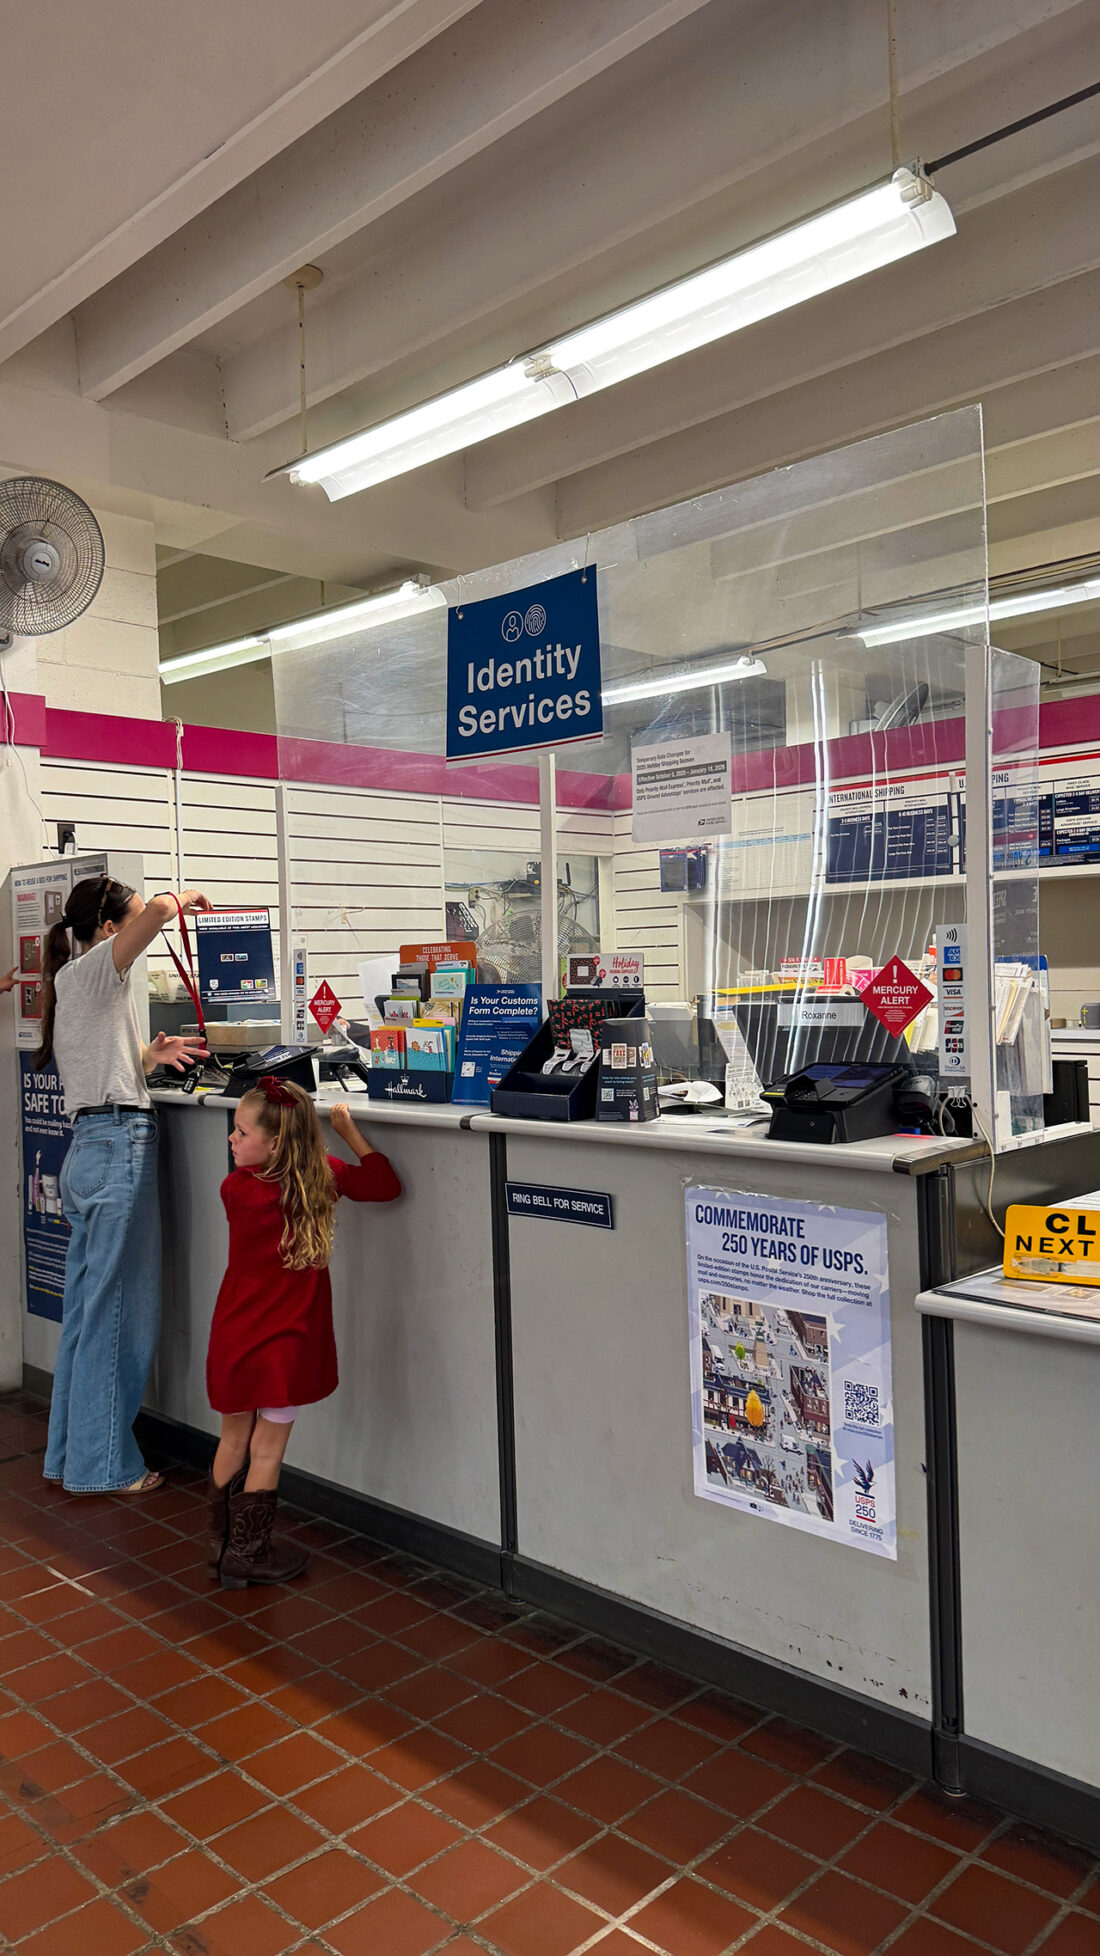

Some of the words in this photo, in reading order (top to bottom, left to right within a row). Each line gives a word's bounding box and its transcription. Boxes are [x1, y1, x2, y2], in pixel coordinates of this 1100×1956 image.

[467, 643, 582, 694] Identity
[457, 690, 591, 737] Services
[666, 751, 684, 759] Changes
[661, 759, 678, 768] Shipping
[686, 780, 700, 788] Priority
[828, 790, 873, 804] NTERNATIONAL
[198, 916, 221, 924] LIMITED
[422, 945, 451, 954] CELEBRATING
[612, 956, 640, 973] Holiday
[873, 985, 918, 995] MERCURY
[470, 996, 478, 1004] Is
[481, 996, 499, 1004] Your
[501, 996, 538, 1004] Customs
[880, 996, 910, 1005] ALERT
[469, 1007, 490, 1015] Form
[492, 1006, 538, 1016] Complete?
[802, 1010, 836, 1020] Roxanne
[23, 1073, 32, 1088] IS
[33, 1073, 57, 1090] YOUR
[385, 1080, 427, 1099] Hallmark
[25, 1092, 49, 1114] SAFE
[51, 1095, 66, 1115] TO
[32, 1117, 42, 1125] could
[42, 1118, 47, 1126] be
[48, 1120, 62, 1130] mailing
[512, 1193, 531, 1204] RING
[533, 1195, 552, 1207] BELL
[554, 1198, 570, 1209] FOR
[571, 1200, 604, 1215] SERVICE
[695, 1204, 805, 1238] COMMEMORATE
[1015, 1235, 1094, 1256] NEXT
[722, 1232, 747, 1254] 250
[751, 1237, 796, 1263] YEARS
[800, 1245, 819, 1266] OF
[823, 1248, 868, 1275] USPS.
[697, 1261, 730, 1272] limited-edition
[732, 1268, 749, 1276] stamps
[775, 1276, 802, 1286] dedication
[713, 1257, 734, 1266] occasion
[761, 1265, 778, 1273] Postal
[779, 1268, 802, 1278] Service's
[819, 1277, 853, 1288] anniversary,
[698, 1277, 749, 1291] usps.com/250stamps.
[719, 1273, 743, 1283] memories,
[778, 1285, 800, 1294] weather.
[801, 1289, 816, 1297] Shop
[837, 1296, 865, 1305] collection
[855, 1495, 876, 1508] USPS
[855, 1504, 876, 1519] 250
[849, 1519, 883, 1535] DELIVERING
[850, 1526, 869, 1537] SINCE
[870, 1531, 882, 1541] 1775
